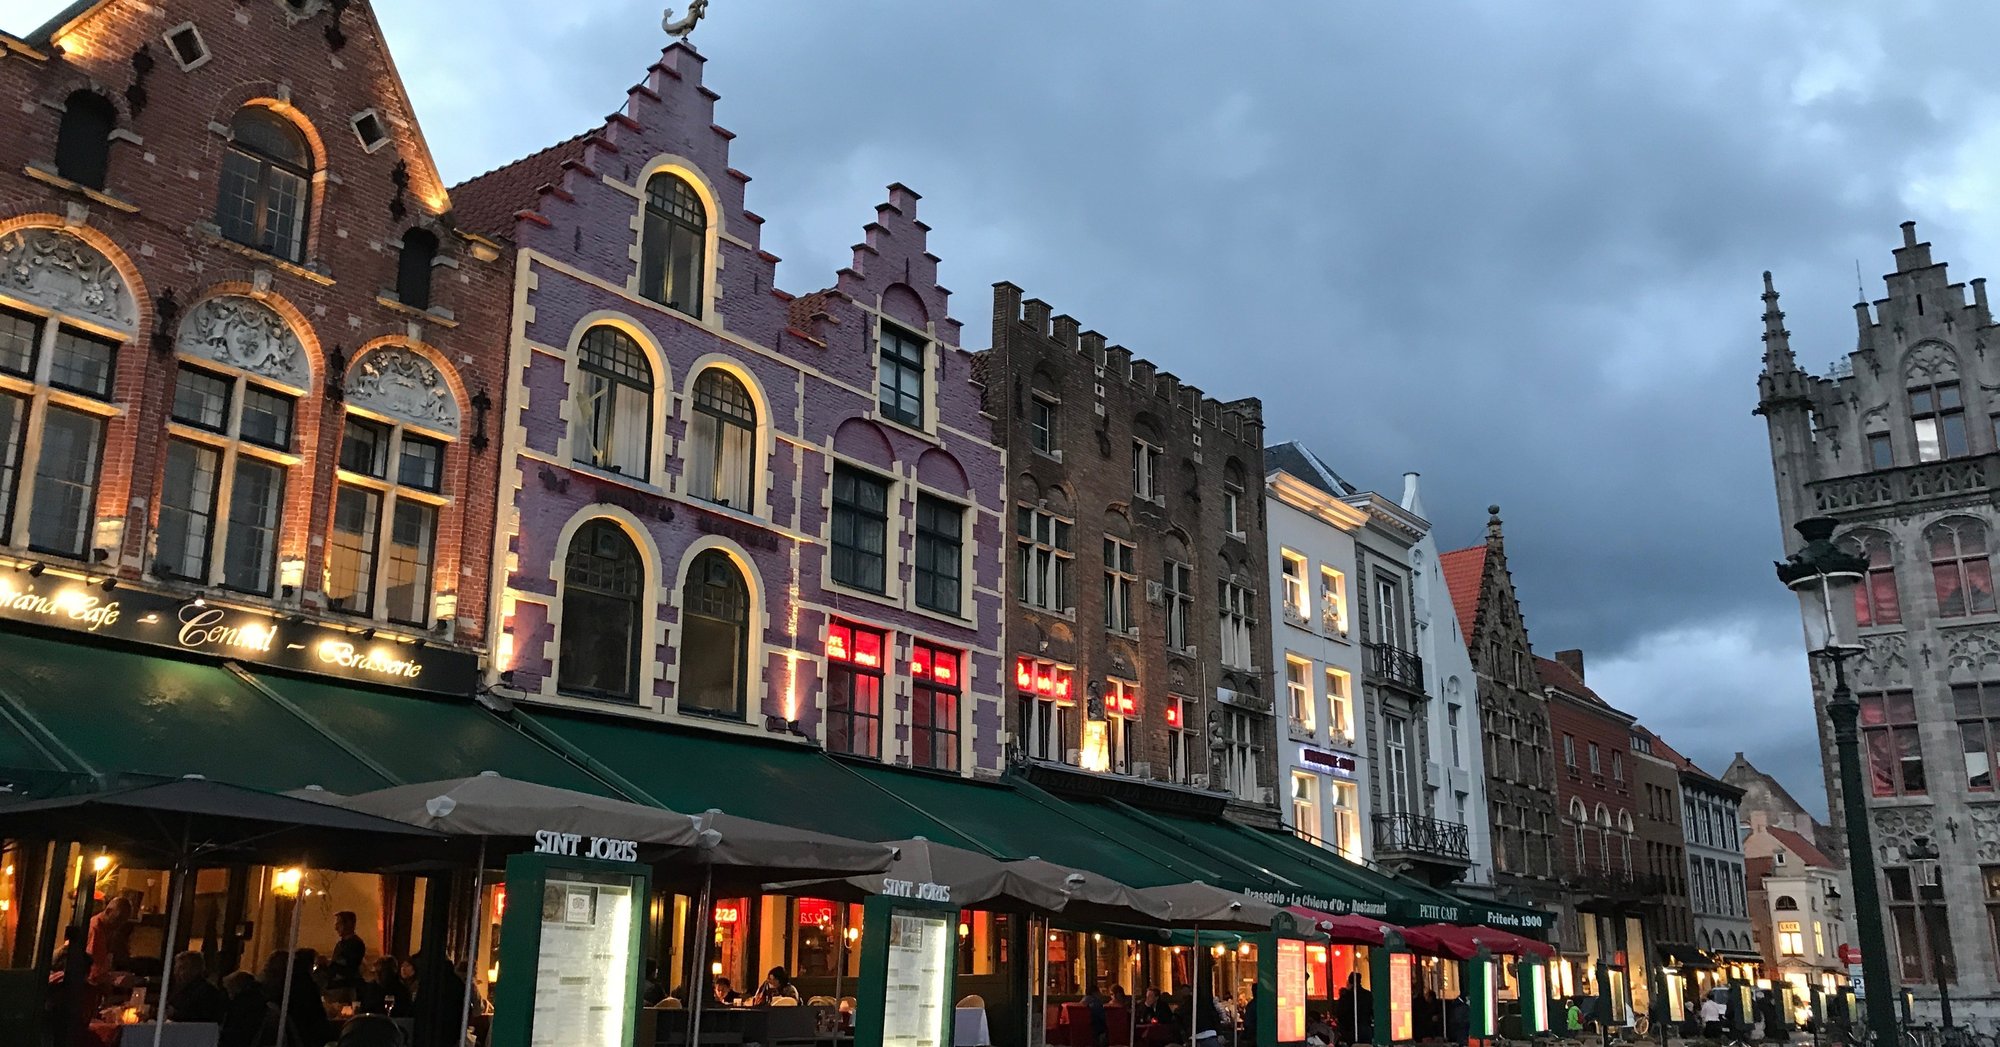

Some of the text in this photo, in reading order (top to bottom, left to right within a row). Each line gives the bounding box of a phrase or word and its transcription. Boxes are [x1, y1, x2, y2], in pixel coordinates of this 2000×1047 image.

[0, 588, 58, 615] rand
[318, 642, 422, 677] Brasserie
[534, 830, 637, 862] SINT JORIS
[882, 878, 950, 902] SINT JORIS
[1244, 887, 1285, 904] Brasserie
[1291, 893, 1301, 906] La
[1329, 898, 1345, 912] d'Or
[1351, 899, 1387, 914] Restaurant
[715, 908, 738, 922] zza
[1420, 904, 1440, 919] PETIT
[1487, 911, 1542, 927] Friterie 1900
[1854, 978, 1862, 989] P
